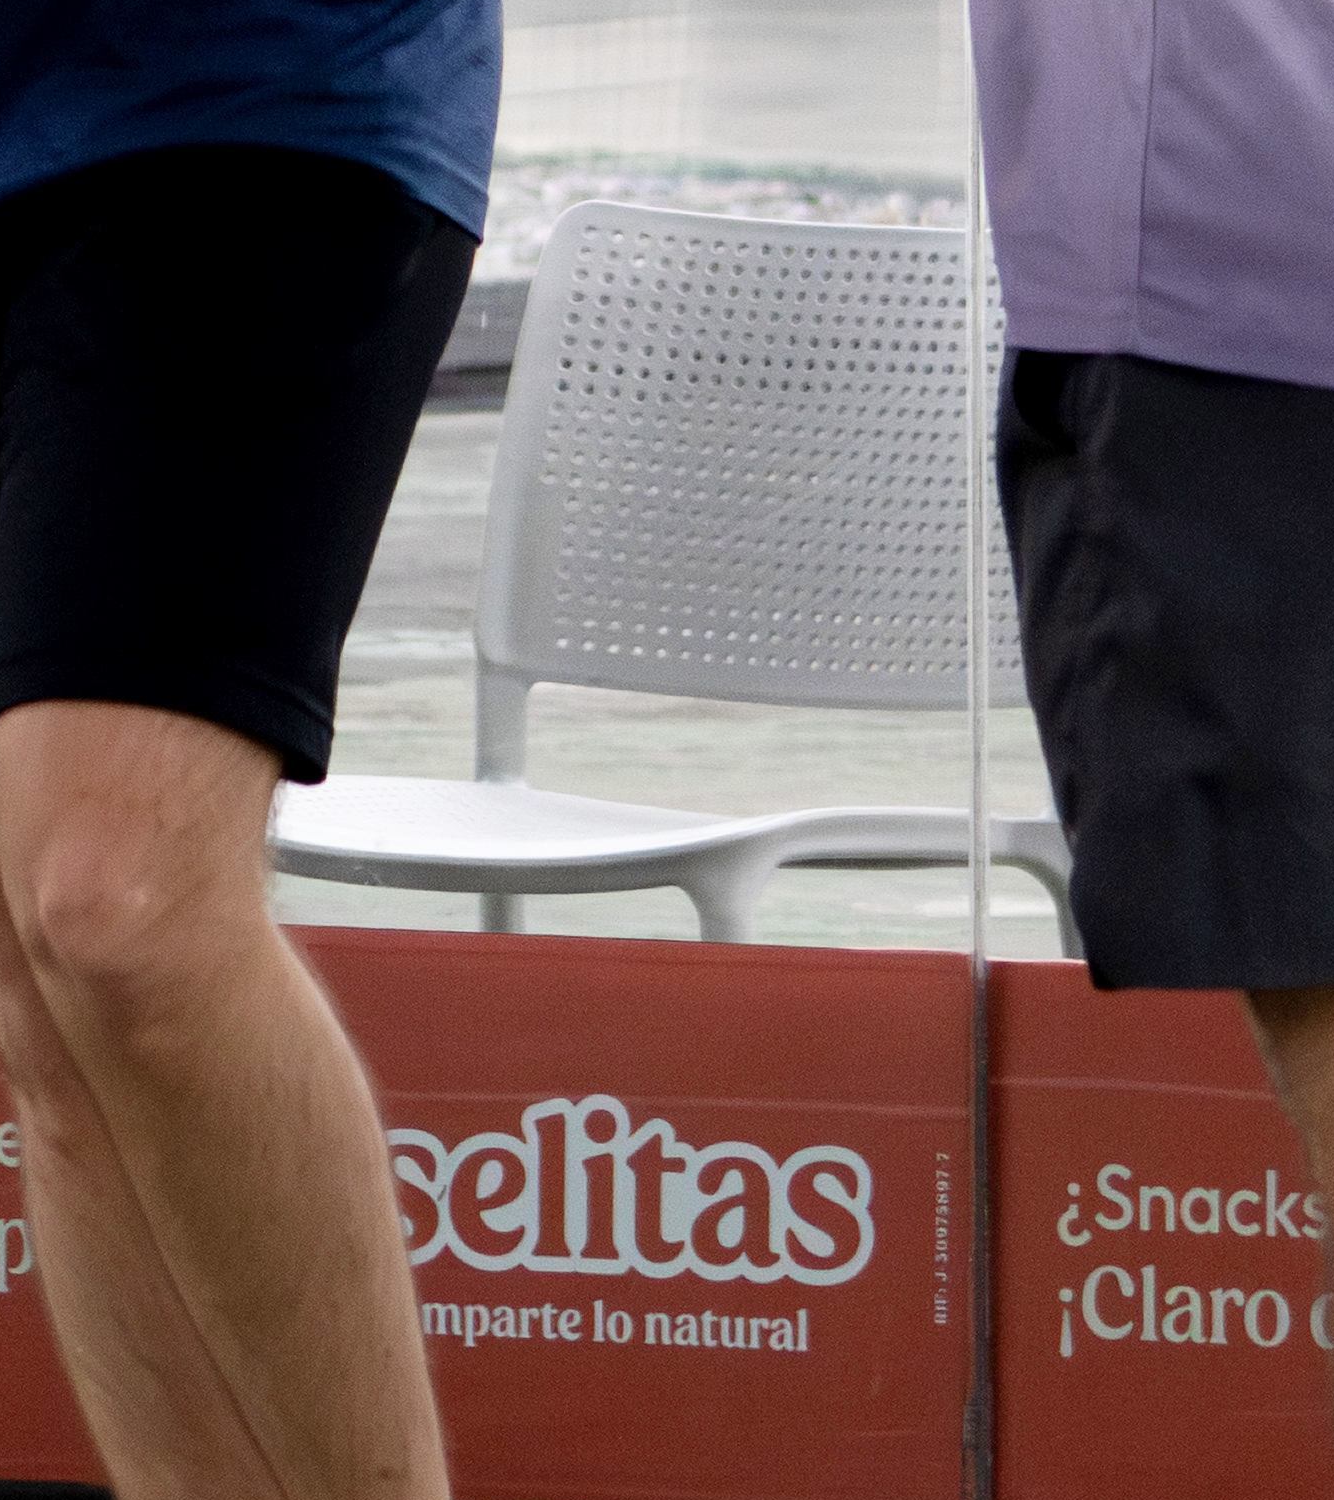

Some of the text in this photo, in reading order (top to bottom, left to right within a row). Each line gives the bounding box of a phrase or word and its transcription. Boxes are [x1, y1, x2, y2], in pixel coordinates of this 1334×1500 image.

[384, 1094, 875, 1286] selitas
[1058, 1164, 1332, 1248] ¿Snacks
[422, 1300, 808, 1352] mparte lo natural
[1060, 1265, 1291, 1357] ¡Claro
